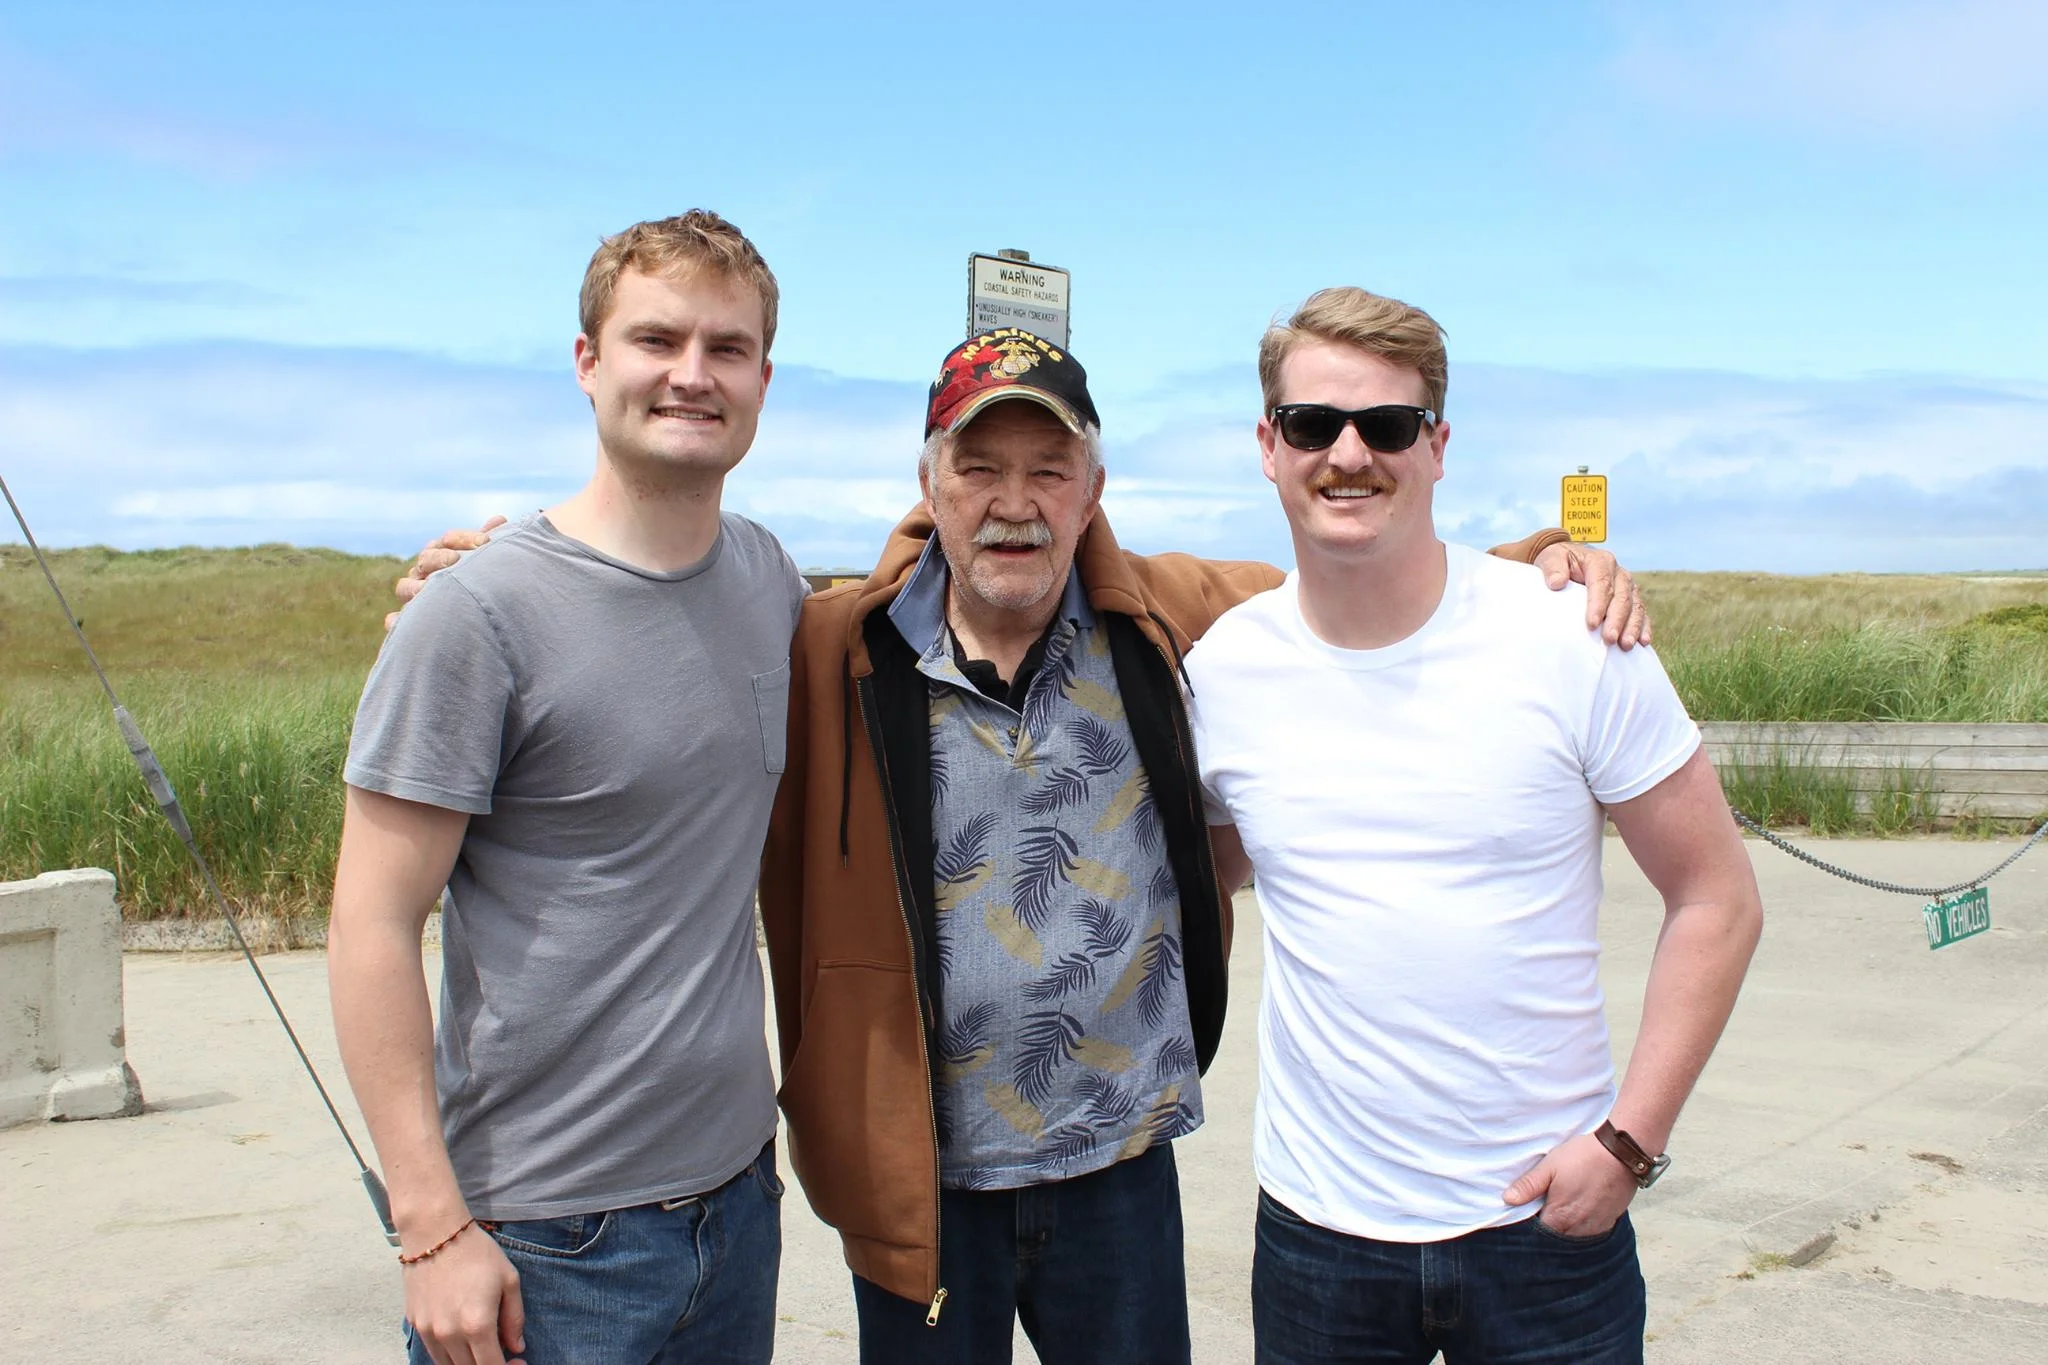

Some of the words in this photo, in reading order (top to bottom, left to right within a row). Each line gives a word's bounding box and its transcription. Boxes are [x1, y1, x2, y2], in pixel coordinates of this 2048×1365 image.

[1000, 268, 1045, 287] WARNING
[984, 282, 1008, 295] COASTAL
[1011, 286, 1032, 298] SAFETY
[1034, 291, 1059, 303] HAZARDS
[978, 302, 1010, 316] UNUSUALLY
[1013, 308, 1026, 318] HIGH
[979, 314, 998, 324] WAVES
[961, 327, 1063, 362] MARINES
[1567, 484, 1602, 493] CAUTION
[1571, 497, 1598, 506] STEEP
[1567, 511, 1601, 520] ERODING
[1570, 526, 1597, 535] BANKS
[1923, 911, 1941, 944] NO
[1945, 897, 1987, 939] VEHICLES
